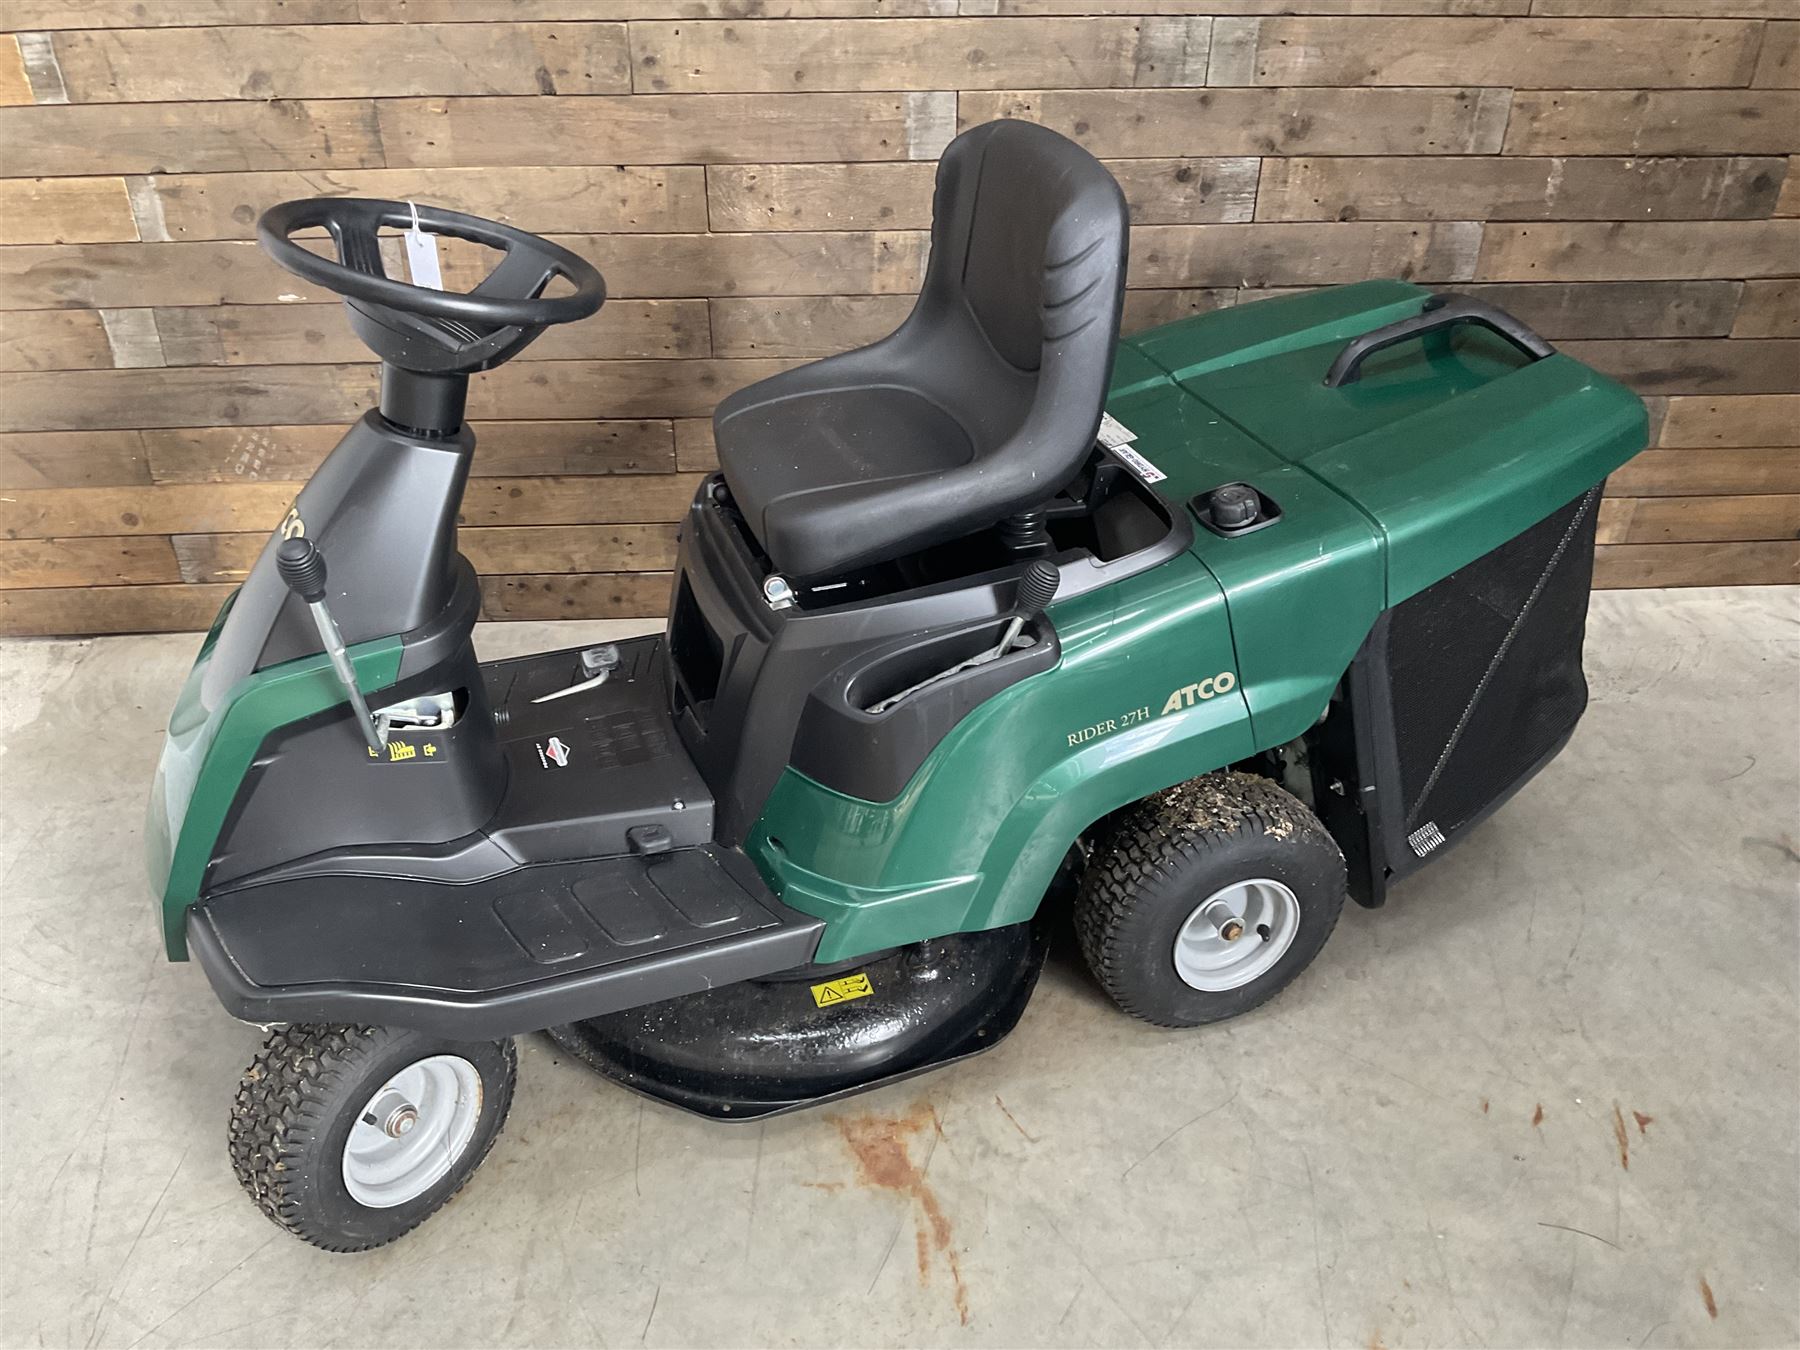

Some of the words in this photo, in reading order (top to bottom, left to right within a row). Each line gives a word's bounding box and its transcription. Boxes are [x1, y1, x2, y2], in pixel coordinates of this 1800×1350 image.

[1160, 671, 1236, 716] ATCO
[1066, 719, 1117, 747] RIDER
[1121, 706, 1151, 727] 27H
